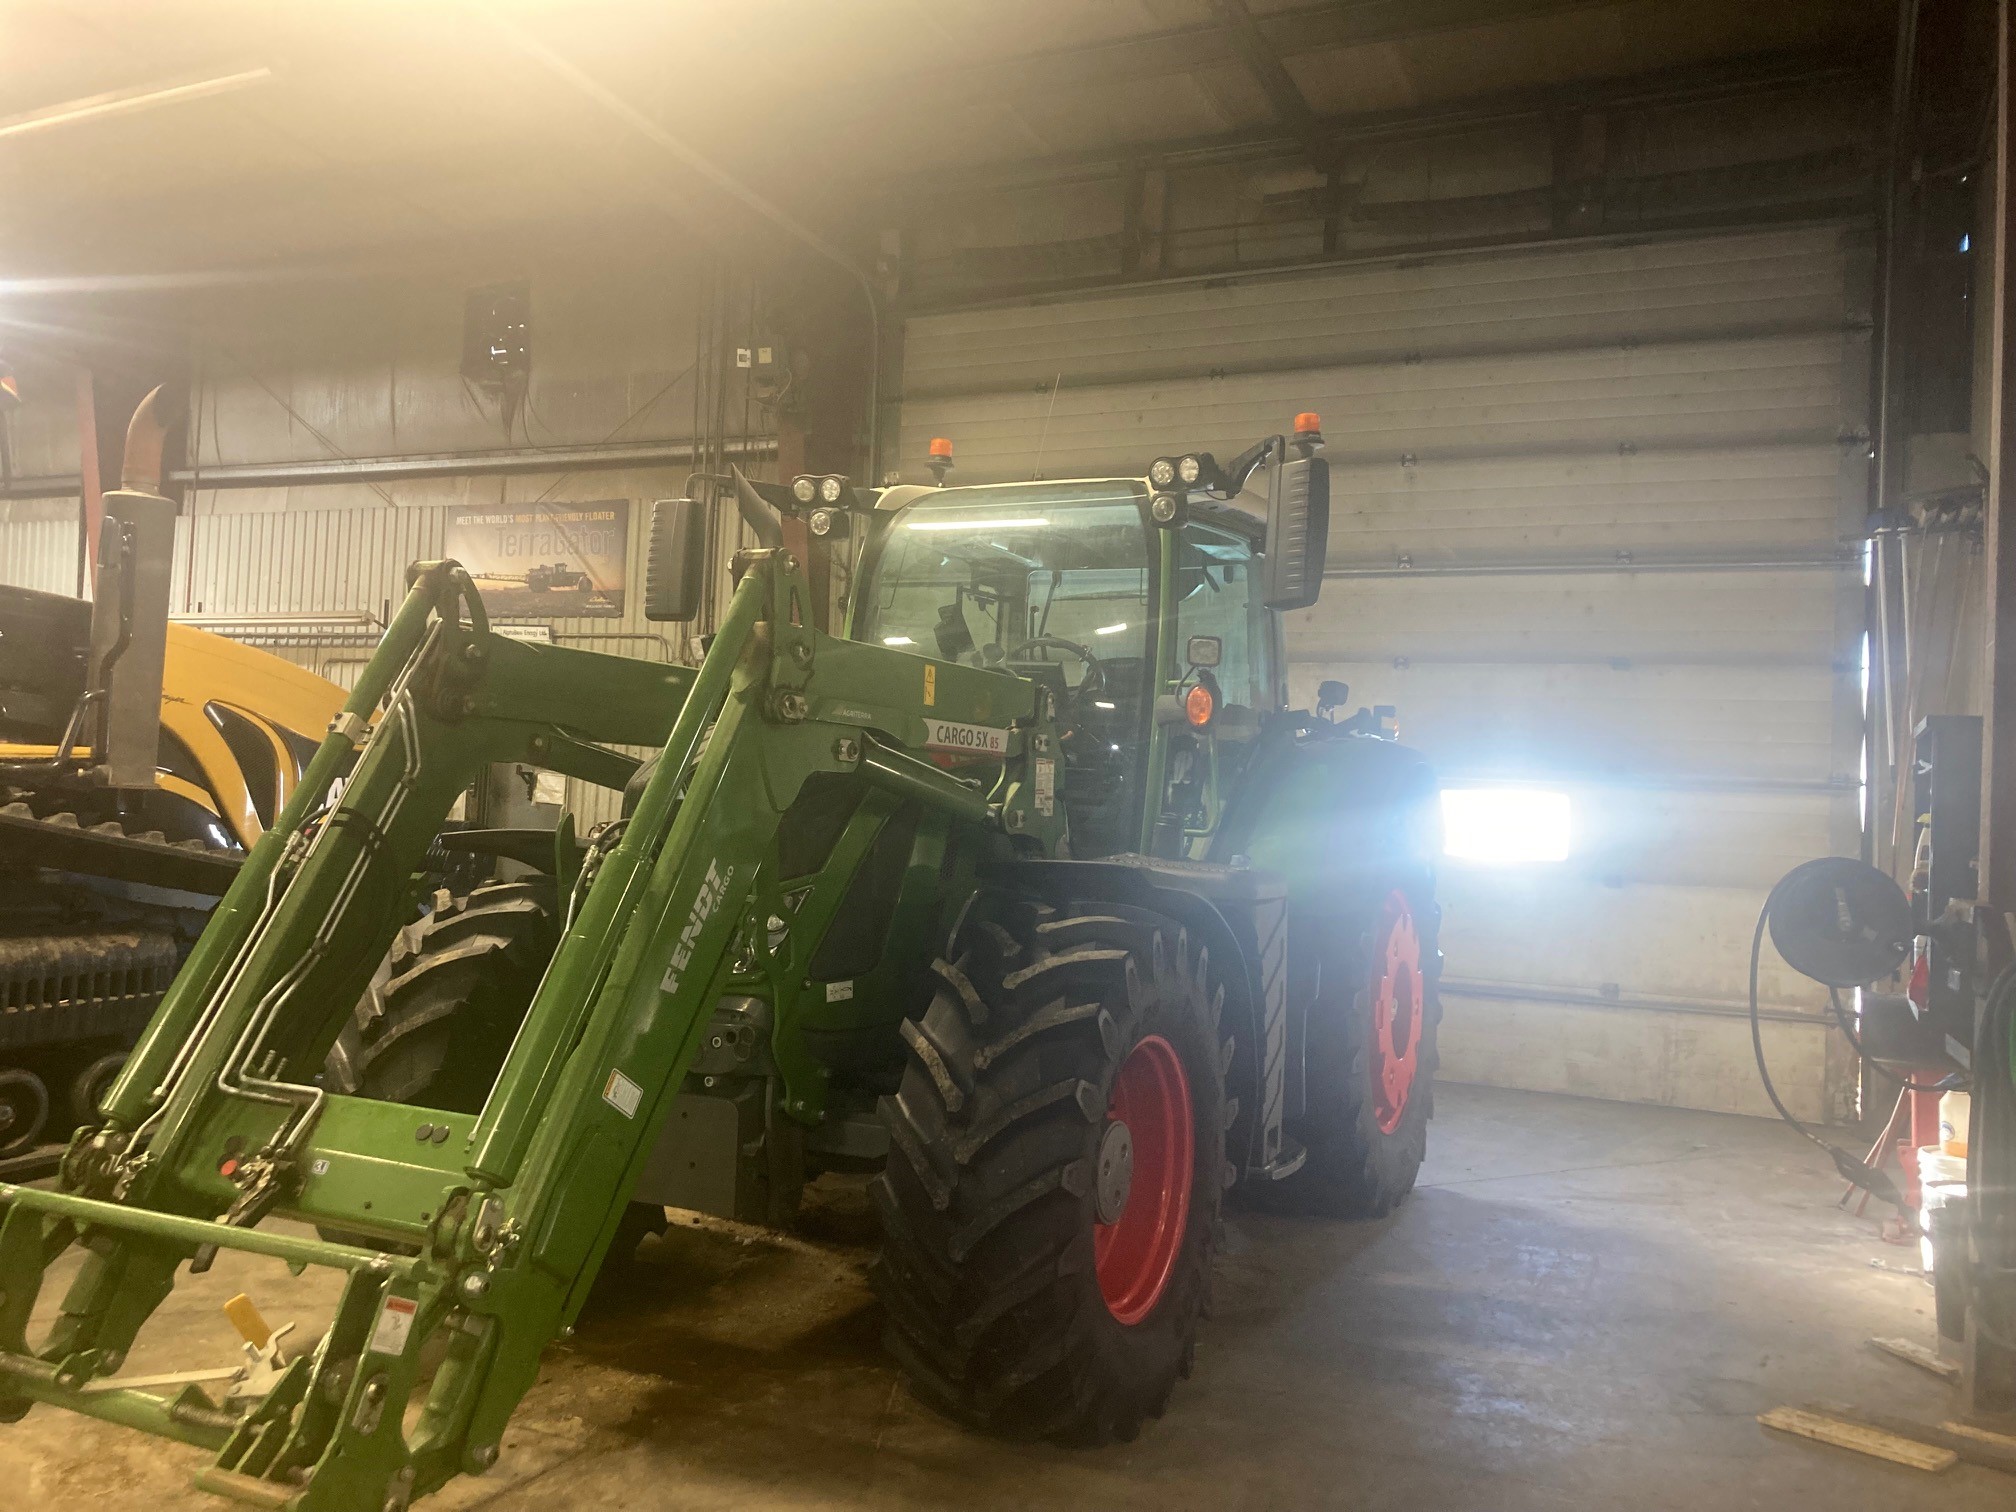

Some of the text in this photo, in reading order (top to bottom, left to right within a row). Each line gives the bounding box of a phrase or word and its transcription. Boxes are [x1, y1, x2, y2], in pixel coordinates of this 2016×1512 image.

[456, 516, 472, 525] MEET
[473, 515, 484, 525] THE
[485, 514, 514, 524] WORLD'S
[515, 514, 533, 523] MOST
[584, 511, 615, 521] FLOATER
[936, 725, 999, 749] CARGO 5X 85
[712, 865, 734, 913] CARGO
[660, 857, 721, 994] FENDT
